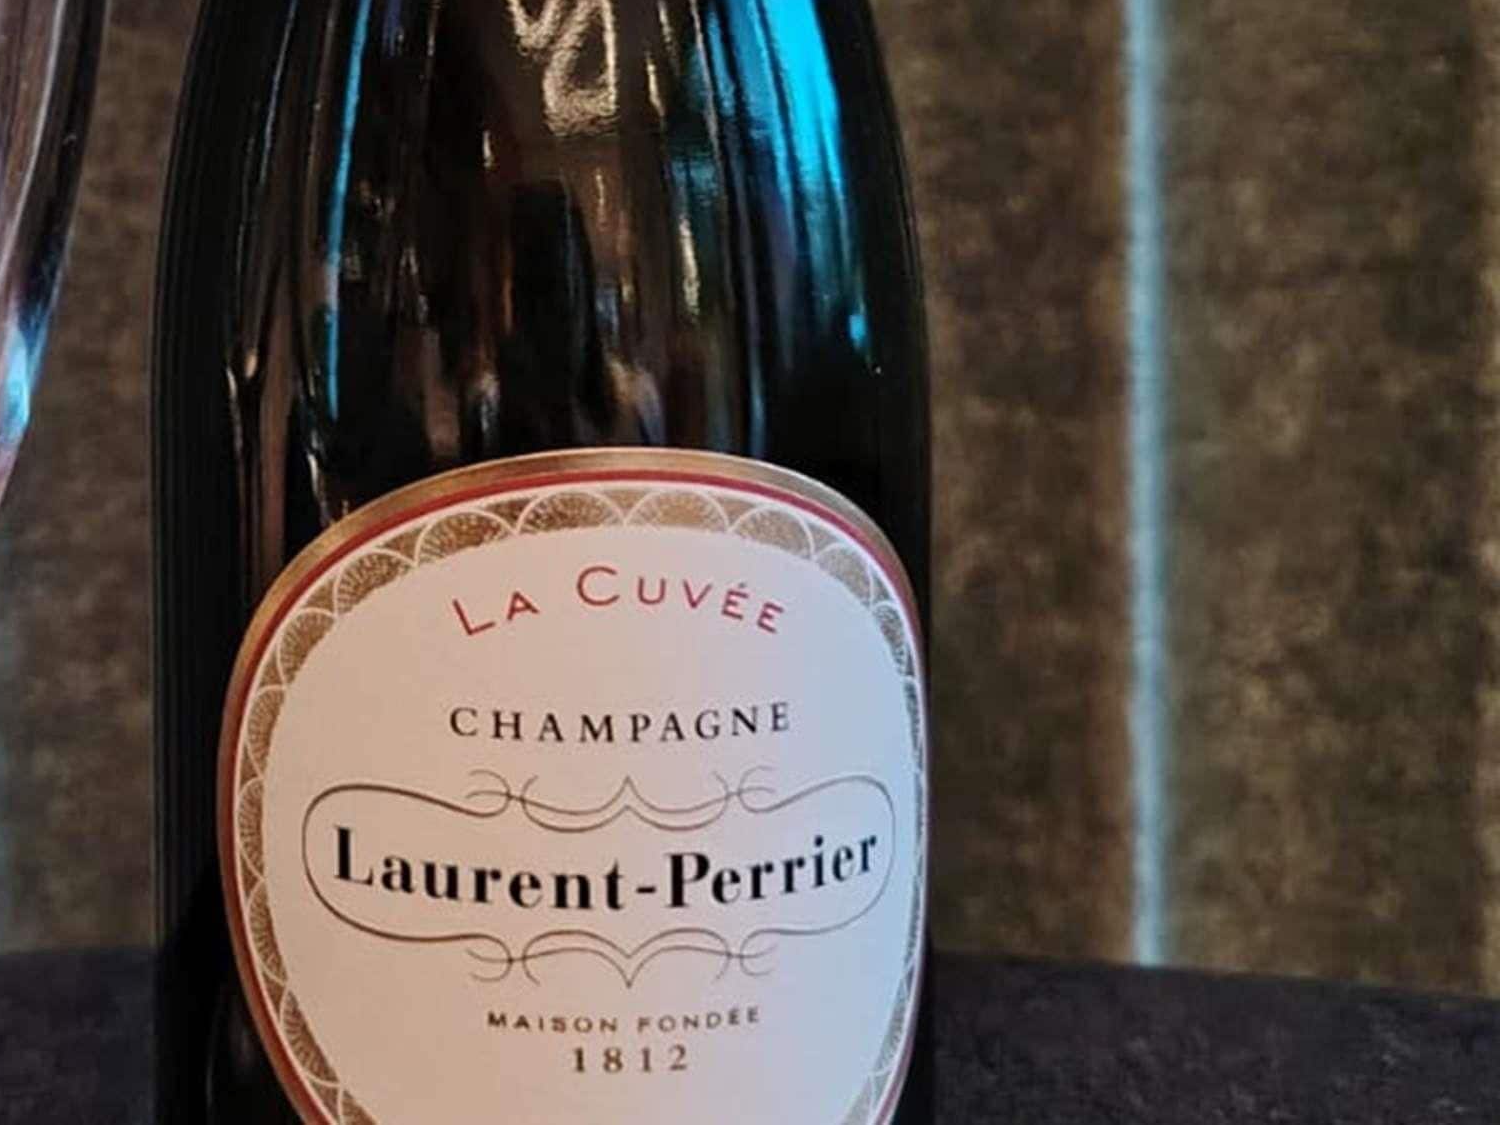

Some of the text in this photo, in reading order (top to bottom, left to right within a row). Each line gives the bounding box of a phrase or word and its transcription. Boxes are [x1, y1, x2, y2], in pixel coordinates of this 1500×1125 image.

[452, 566, 785, 636] LA CUVÉE
[449, 702, 790, 744] CHAMPAGNE
[333, 825, 879, 912] Laurent-Perrier
[486, 1006, 761, 1034] MAISON FONDÉE
[573, 1044, 688, 1074] 1812
